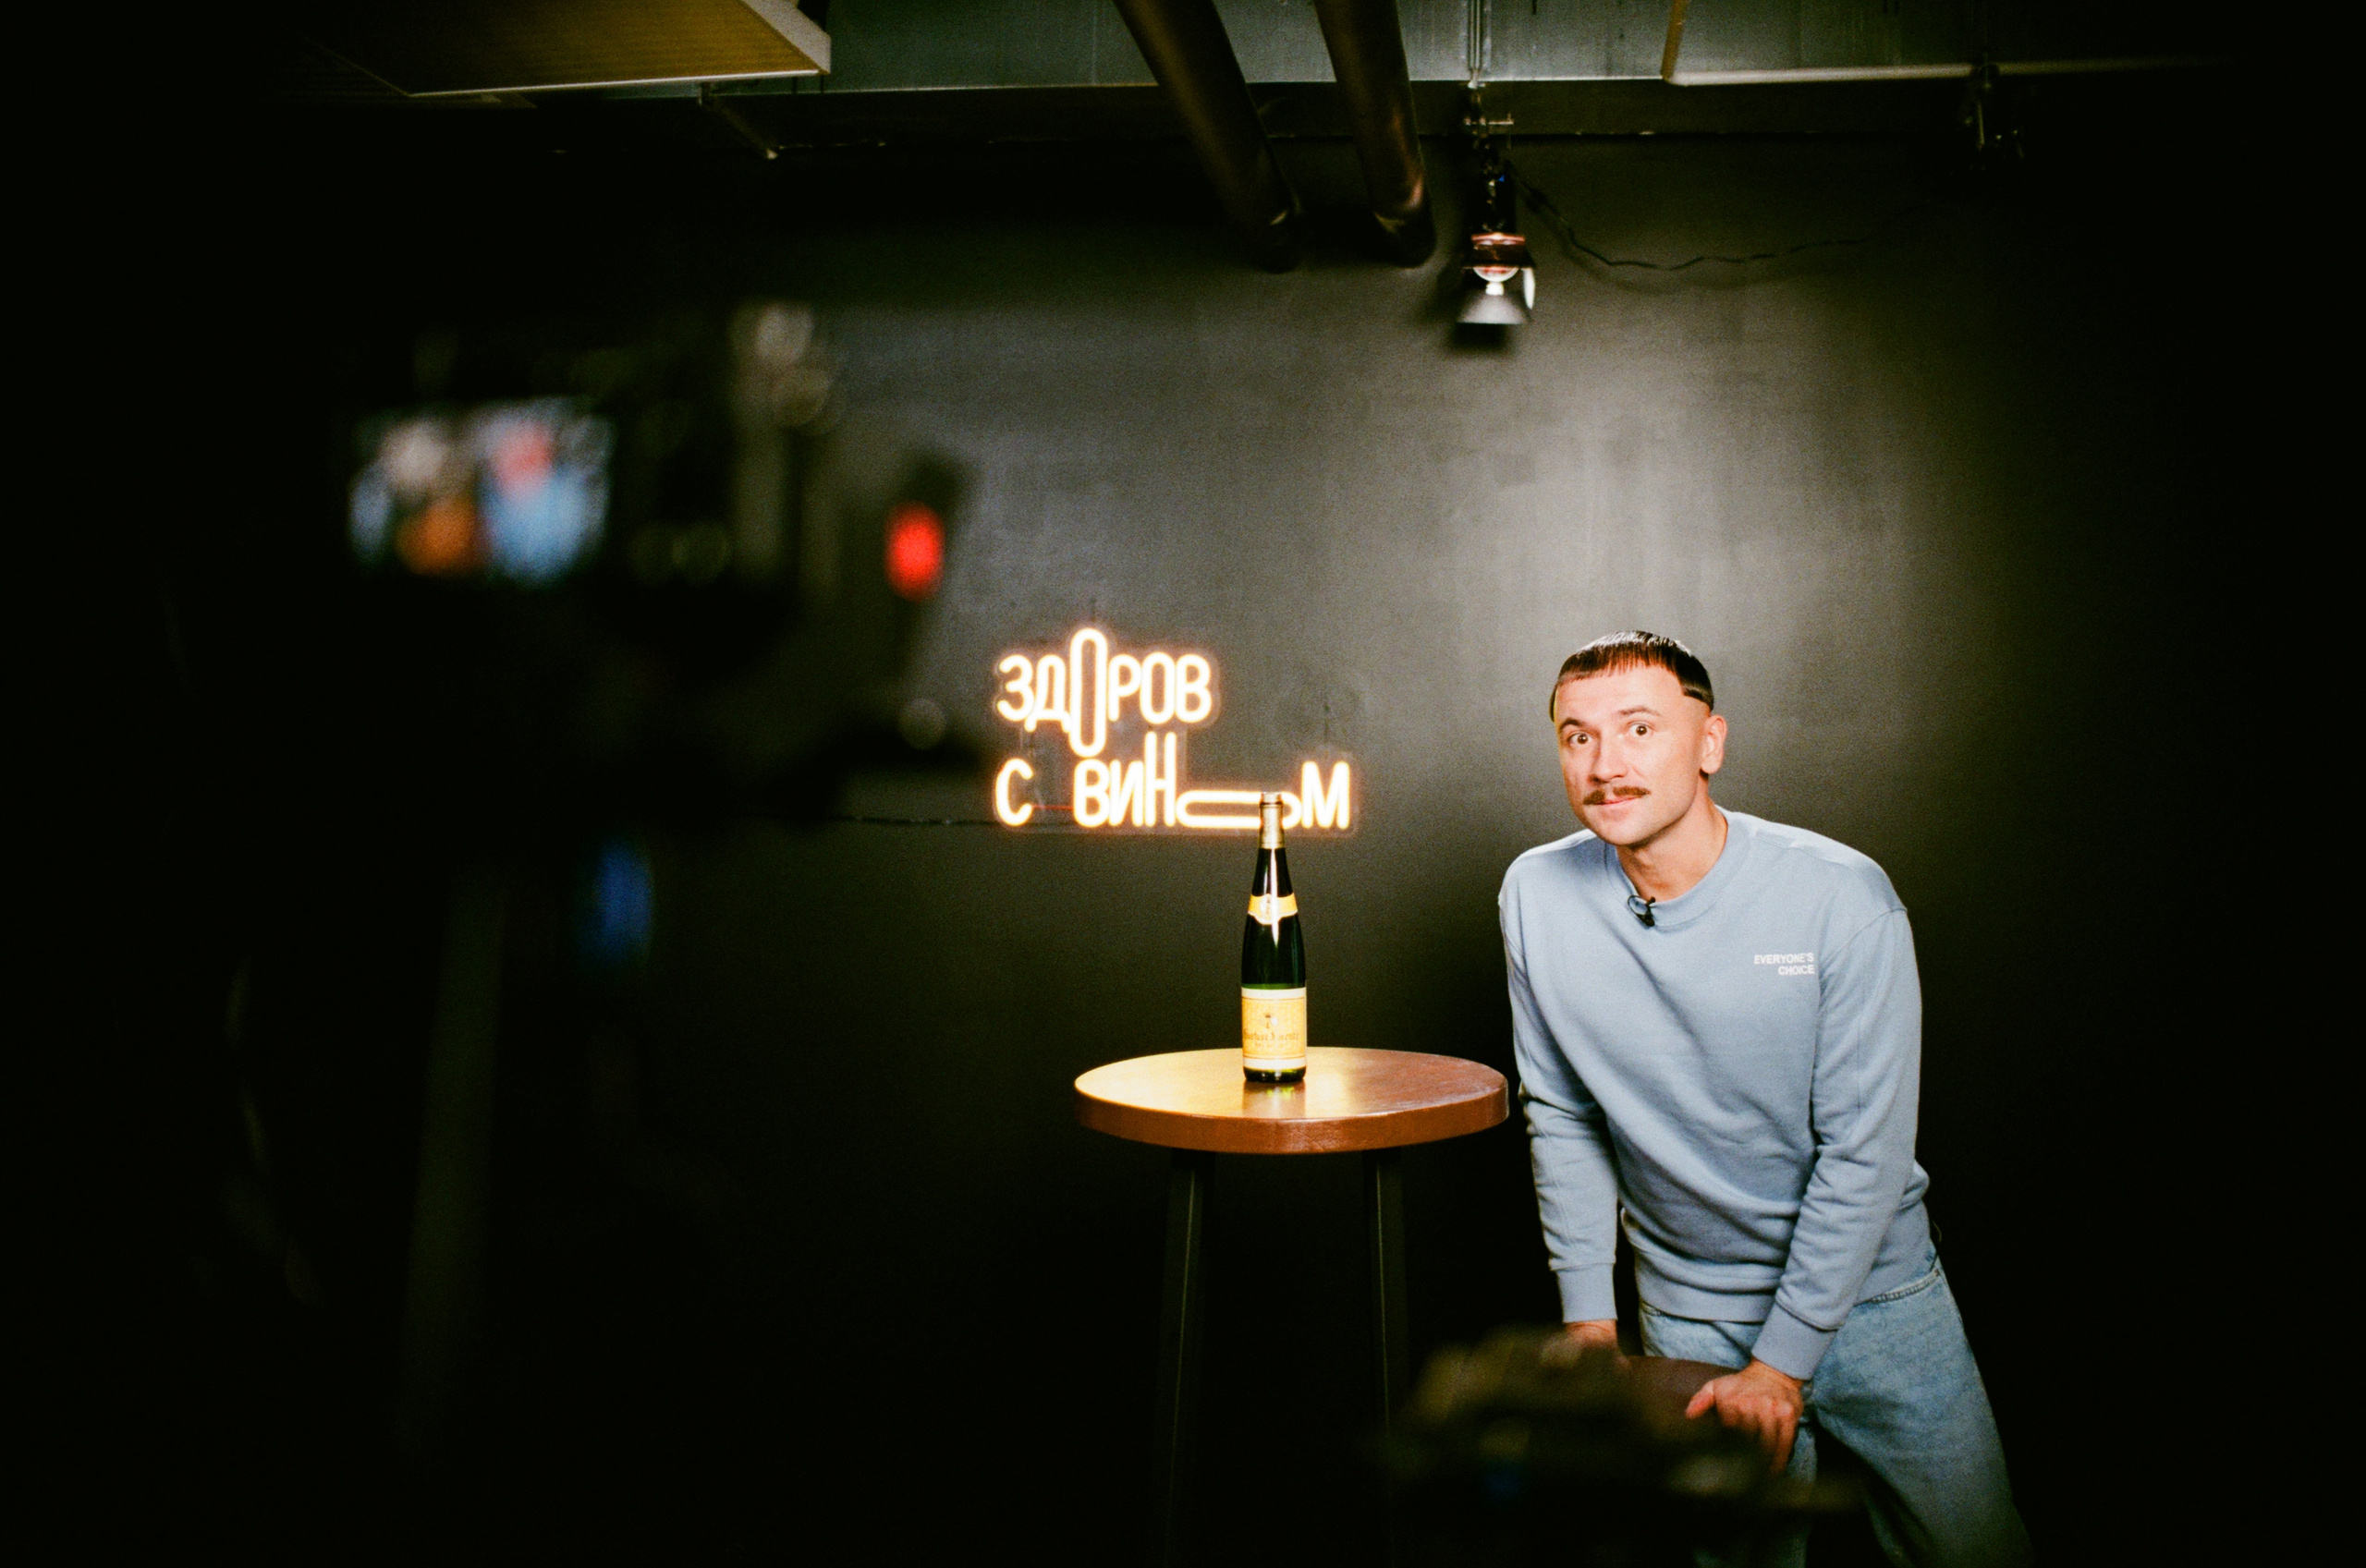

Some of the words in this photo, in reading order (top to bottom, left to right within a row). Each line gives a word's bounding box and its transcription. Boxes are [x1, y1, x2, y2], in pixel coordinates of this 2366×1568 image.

[996, 627, 1212, 758] ЗДОРОВ
[995, 759, 1034, 826] С
[1074, 731, 1350, 829] ВИНОМ
[1754, 953, 1814, 965] EVERYONE'S
[1778, 965, 1815, 976] CHOICE
